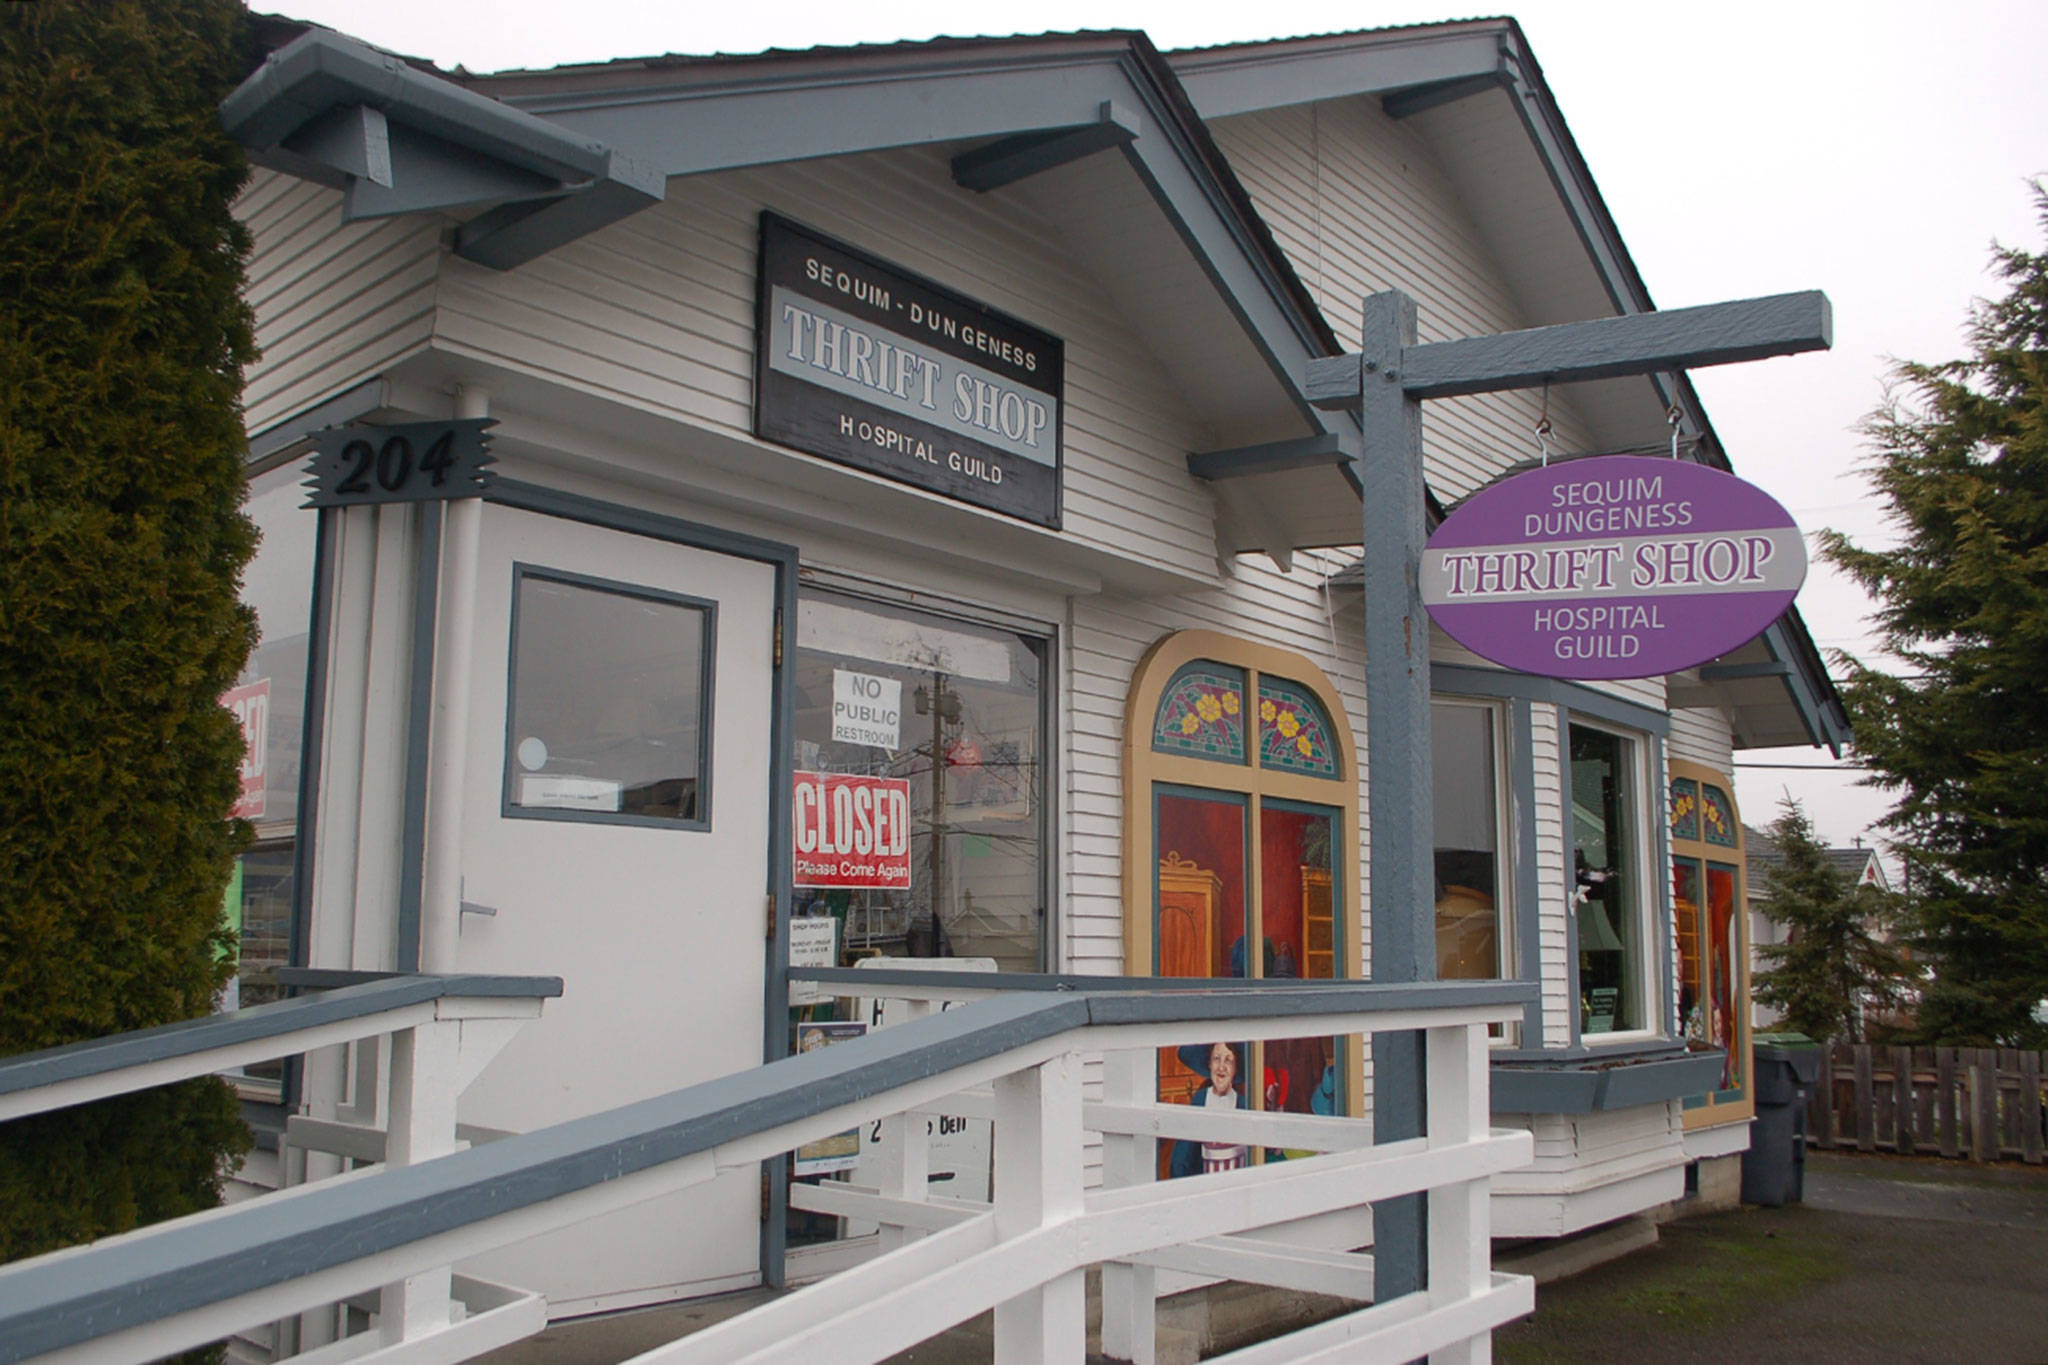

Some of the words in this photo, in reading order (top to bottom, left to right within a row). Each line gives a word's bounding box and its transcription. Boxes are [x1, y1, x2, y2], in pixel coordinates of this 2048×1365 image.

[806, 257, 890, 311] SEQUIM
[909, 302, 1037, 372] DUNGENESS
[783, 304, 942, 411] THRIFT
[952, 371, 1048, 449] SHOP
[335, 430, 458, 495] 204
[840, 413, 938, 465] HOSPITAL
[948, 451, 1002, 485] GUILD
[1551, 475, 1663, 508] SEQUIM
[1524, 501, 1693, 537] DUNGENESS
[1442, 543, 1622, 598] THRIFT
[1630, 535, 1775, 589] SHOP
[1533, 605, 1665, 632] HOSPITAL
[1554, 634, 1640, 660] GUILD
[852, 675, 882, 699] NO
[835, 702, 898, 726] PUBLIC
[835, 725, 895, 746] RESTROOM
[795, 782, 907, 857] CLOSED
[797, 860, 838, 876] Please
[840, 861, 875, 877] Come
[877, 862, 908, 880] Again
